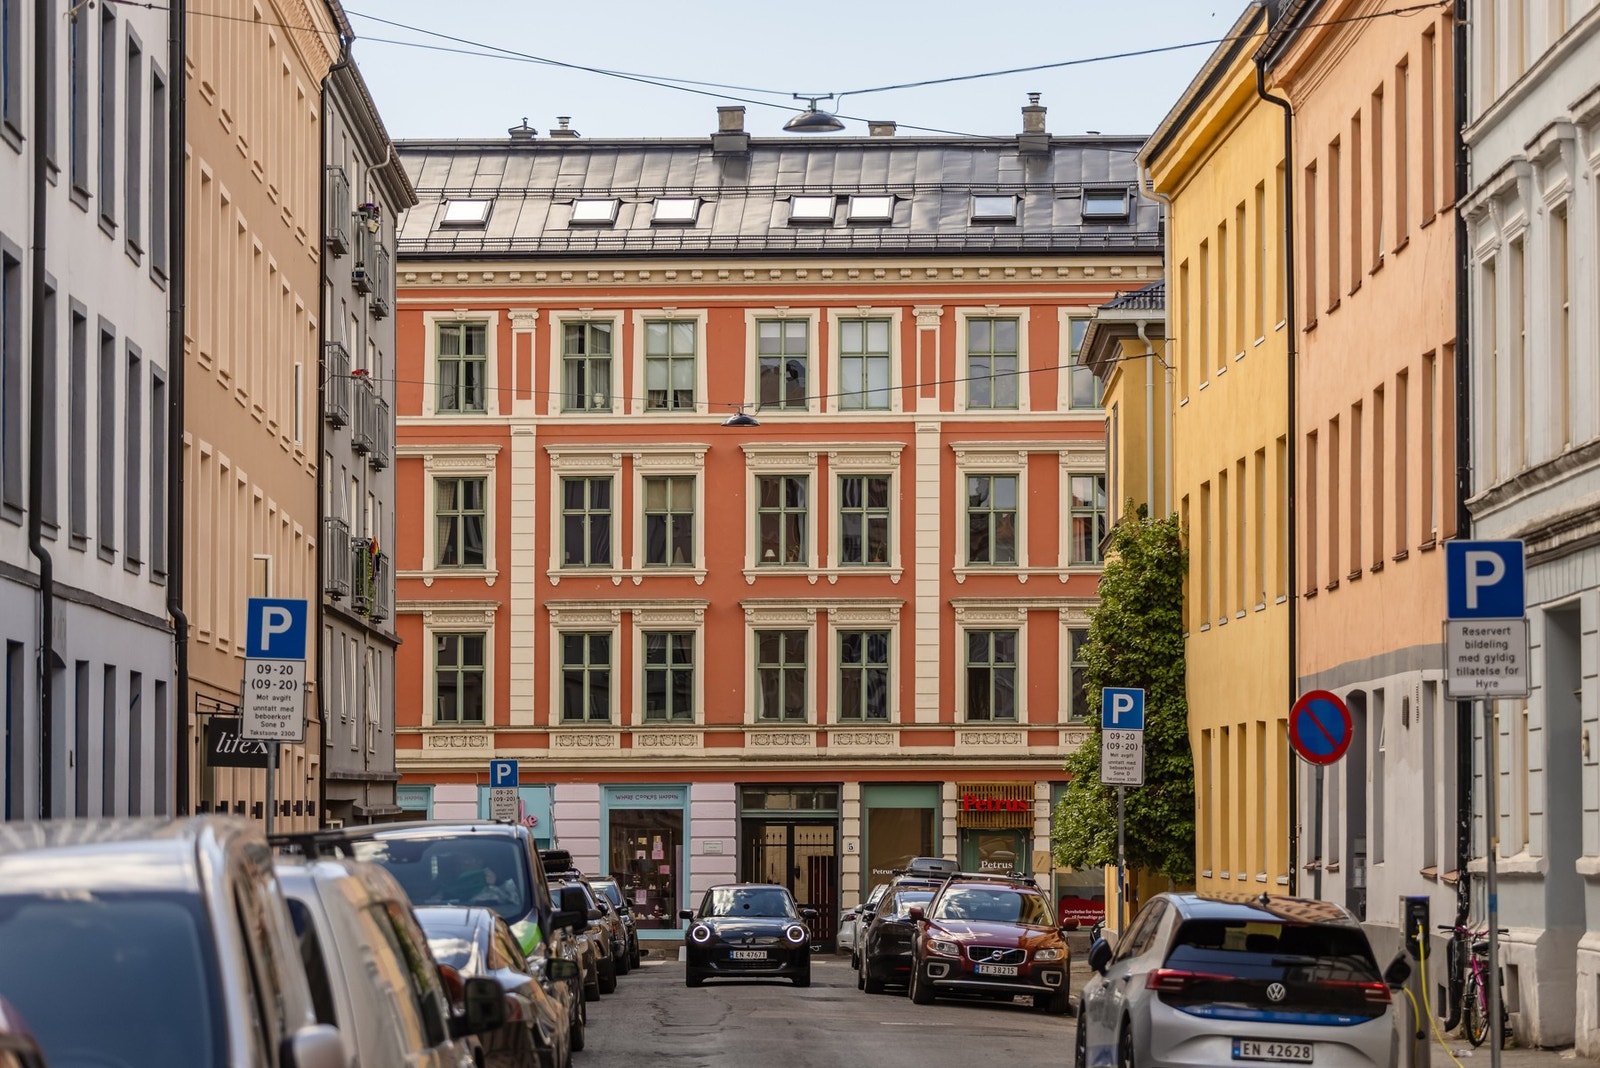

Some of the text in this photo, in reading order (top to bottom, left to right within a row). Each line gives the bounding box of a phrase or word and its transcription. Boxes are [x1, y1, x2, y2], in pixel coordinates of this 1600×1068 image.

[1465, 551, 1506, 609] P
[261, 606, 293, 651] P
[1462, 627, 1511, 636] Reservert
[1465, 641, 1509, 651] bildeling
[1459, 653, 1515, 664] med gyldig
[1456, 666, 1519, 676] tillatelse for
[1476, 680, 1499, 689] Hyre
[1112, 693, 1134, 724] P
[496, 763, 512, 785] P
[962, 794, 1028, 812] Petrus
[981, 860, 1013, 869] Petrus
[992, 966, 1015, 975] 38215
[1243, 1042, 1310, 1059] EN 42628
